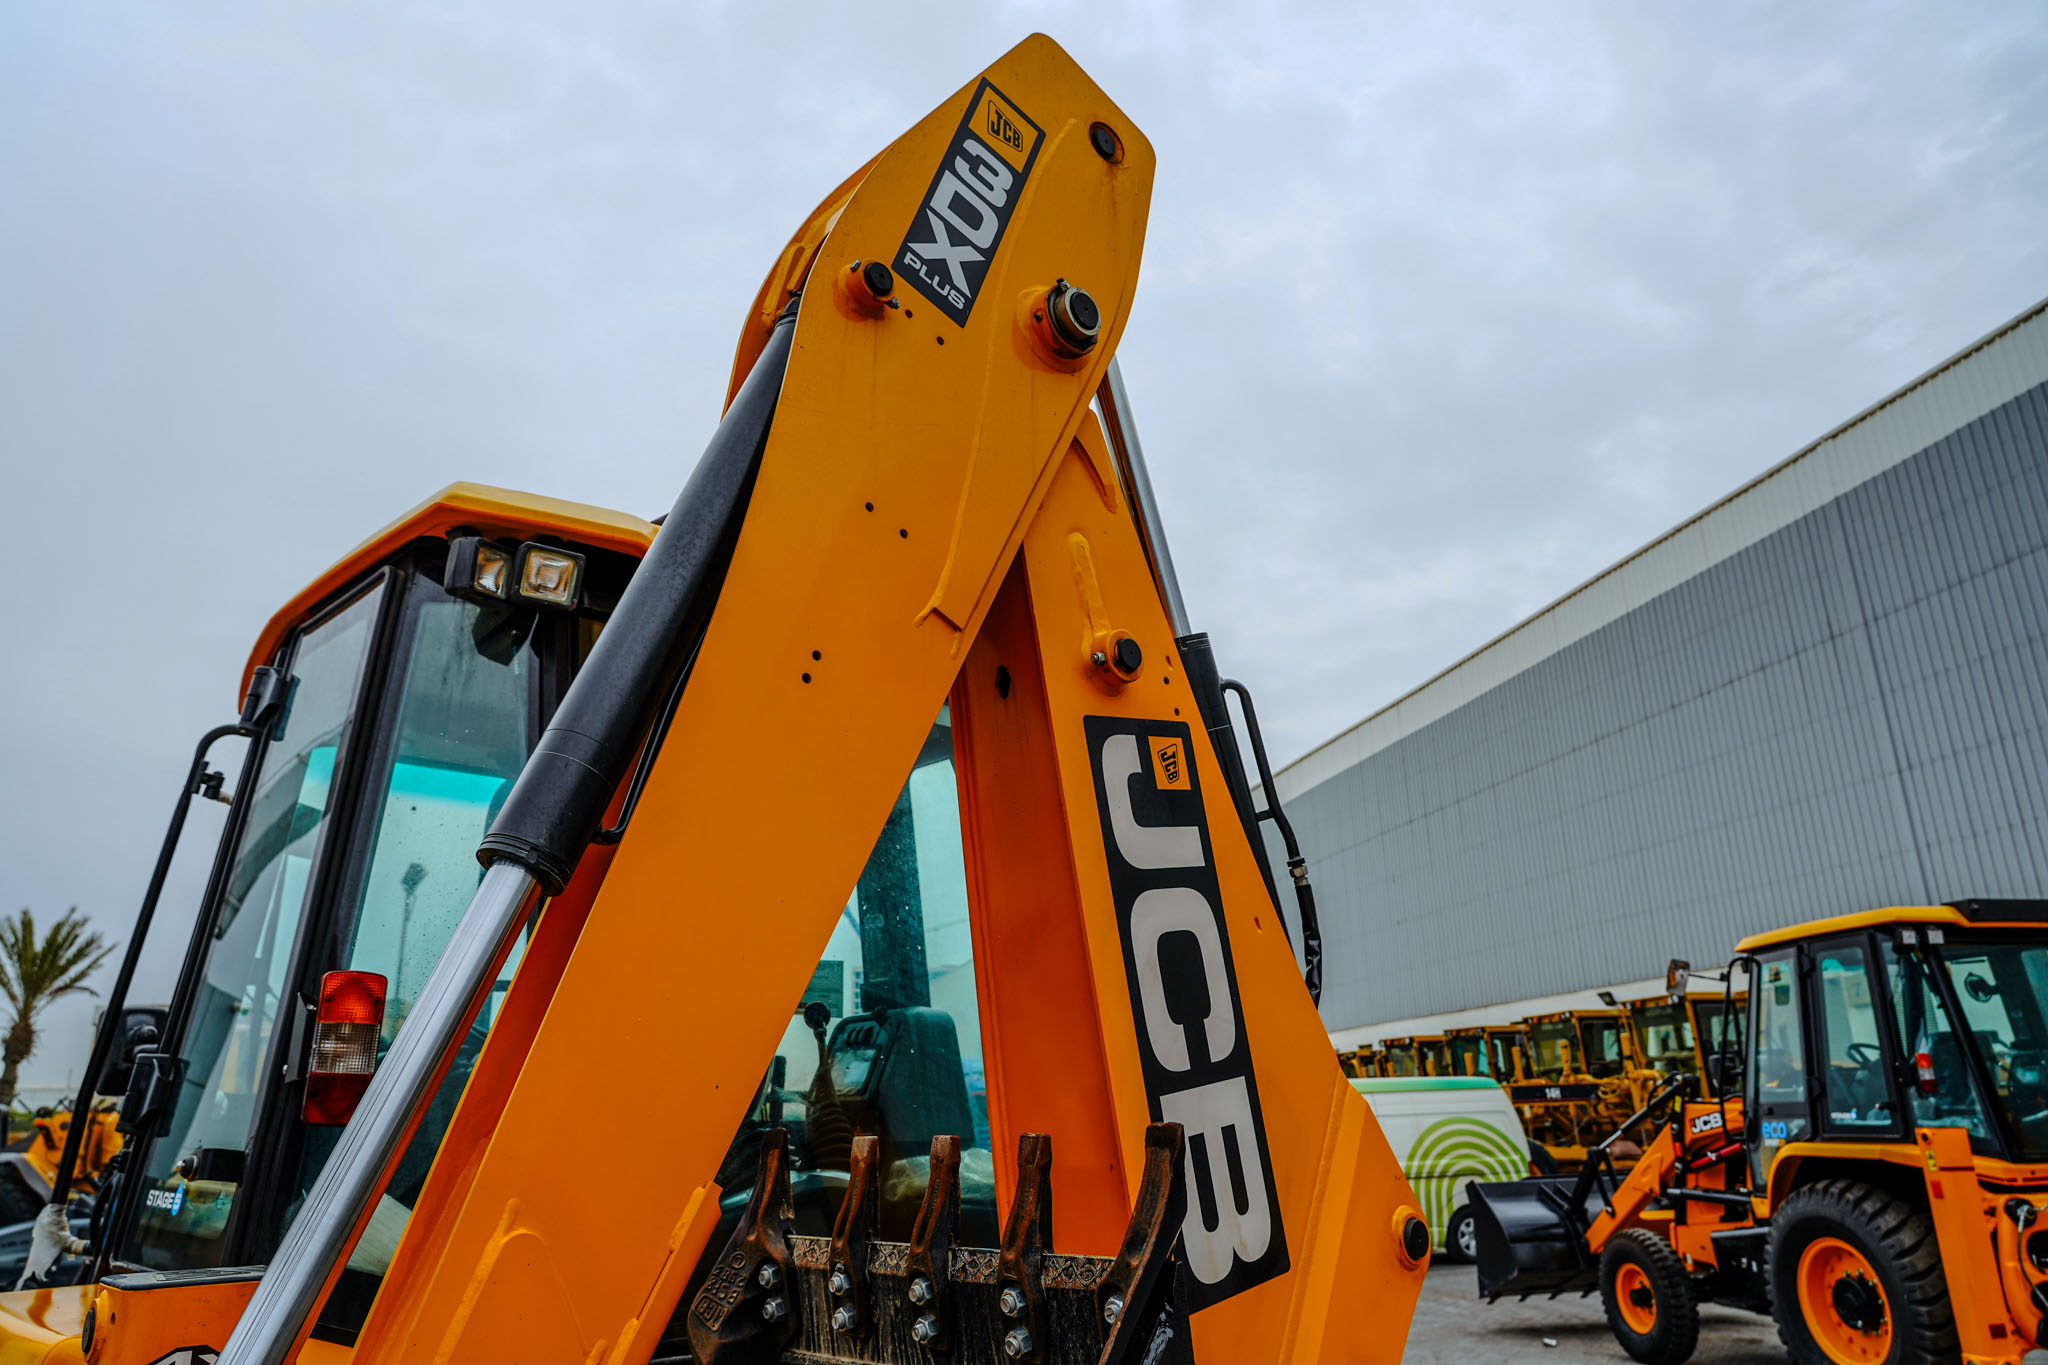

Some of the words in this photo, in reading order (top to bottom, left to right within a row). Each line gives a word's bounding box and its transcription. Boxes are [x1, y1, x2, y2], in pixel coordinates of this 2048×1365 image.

[990, 108, 1022, 150] JCB
[903, 252, 966, 310] PLUS
[1159, 744, 1180, 783] JCB
[1102, 734, 1271, 1285] JCB
[1691, 1112, 1722, 1134] JCB
[1761, 1121, 1787, 1139] eco
